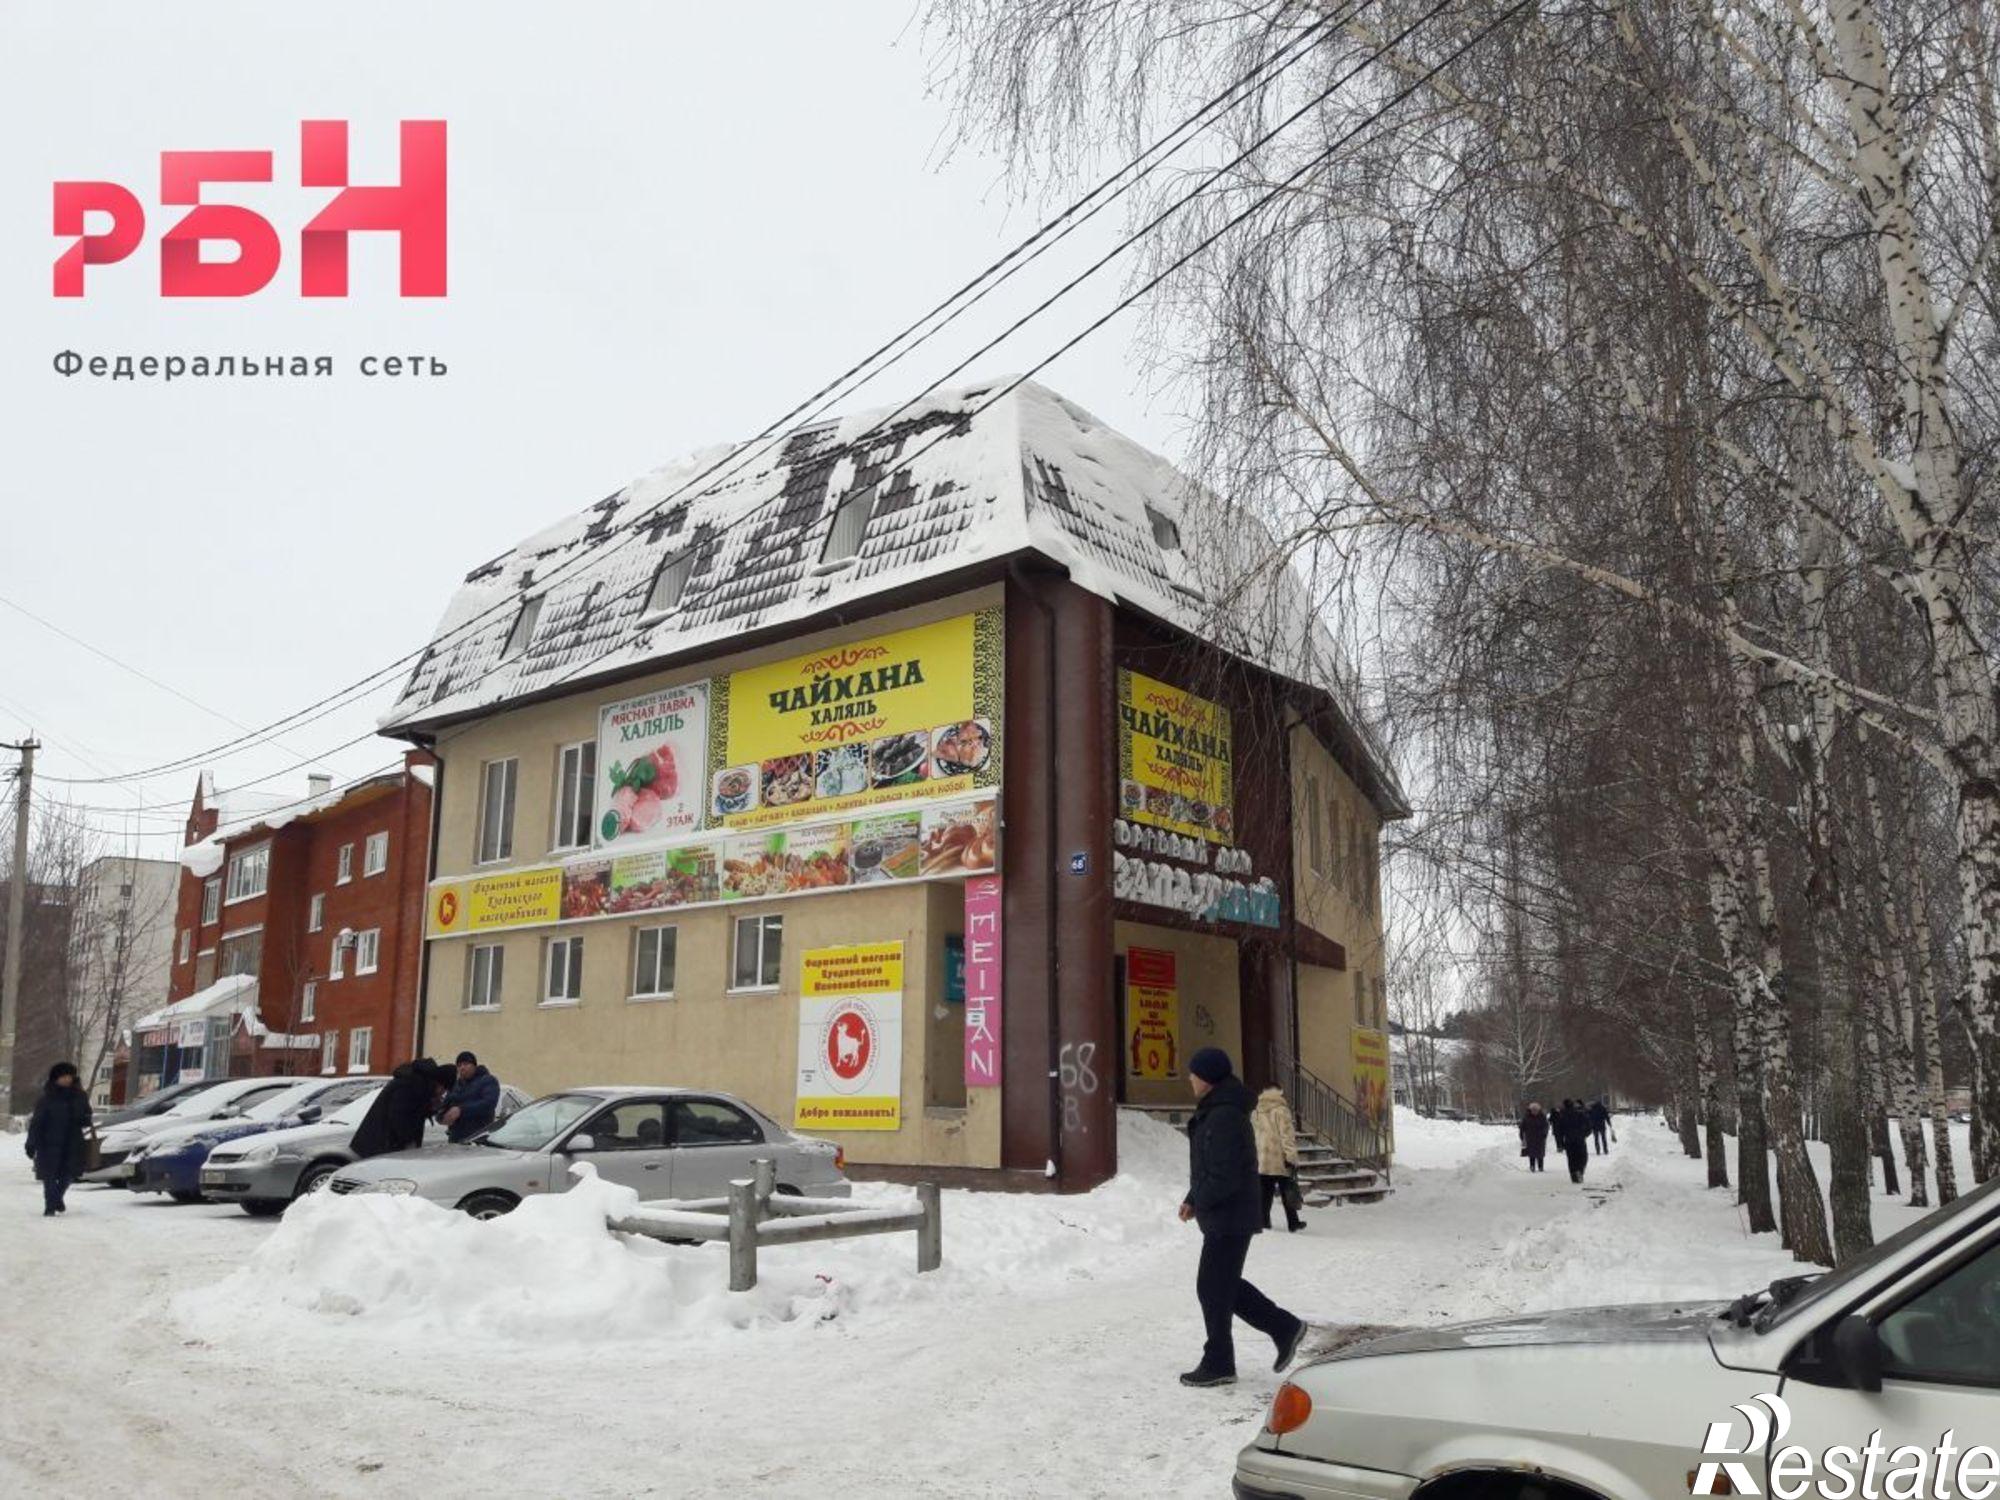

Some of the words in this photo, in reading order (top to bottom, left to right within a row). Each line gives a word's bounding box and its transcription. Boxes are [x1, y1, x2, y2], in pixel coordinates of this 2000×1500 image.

[769, 659, 924, 714] ЧАЙХАНА
[611, 704, 655, 728] МЯСНАЯ
[658, 696, 695, 716] ЛАВКА
[811, 699, 878, 726] ХАЛЯЛЬ
[620, 713, 684, 742] ХАЛЯЛЬ
[1121, 704, 1230, 763] ЧАЙХАНА
[666, 812, 694, 828] ЭТАЖ
[1060, 1042, 1098, 1093] 68
[800, 1106, 829, 1118] Добро
[832, 1106, 895, 1117] пожаловать!
